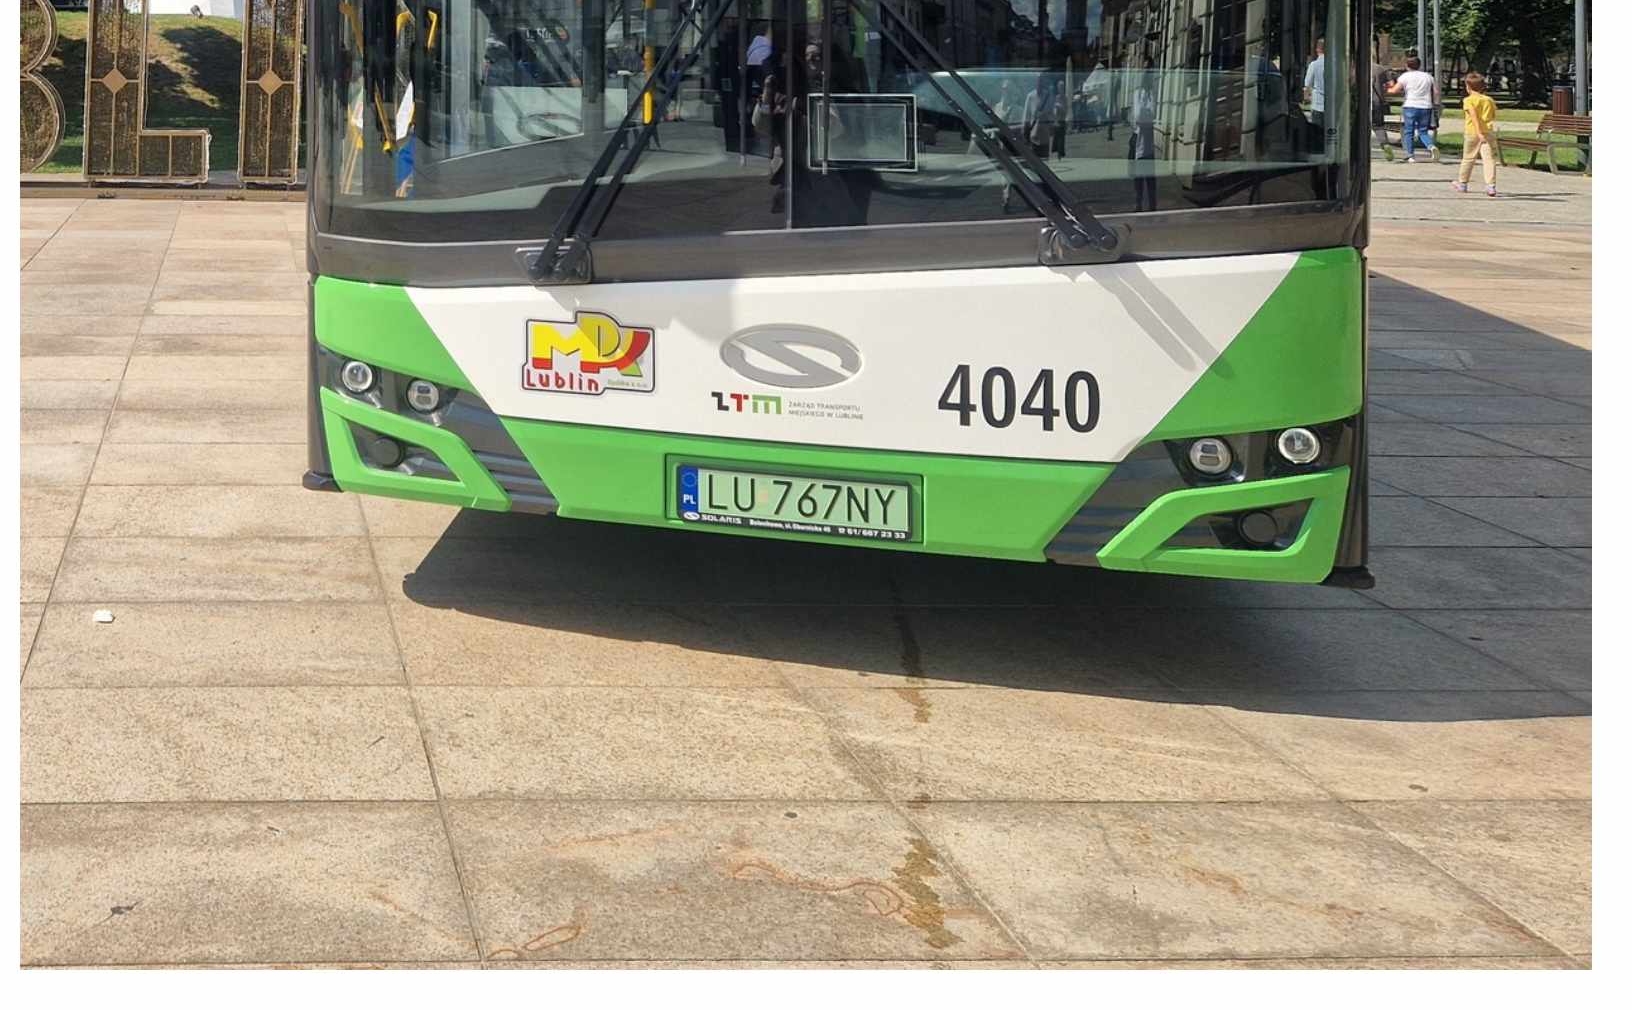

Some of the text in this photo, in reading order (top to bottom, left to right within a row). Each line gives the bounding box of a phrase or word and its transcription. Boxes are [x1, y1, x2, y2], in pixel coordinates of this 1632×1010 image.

[526, 368, 599, 392] Lublin
[938, 364, 1100, 433] 4040
[683, 493, 696, 505] PL
[708, 474, 896, 526] LU 767NY
[701, 513, 742, 525] SOLARIS
